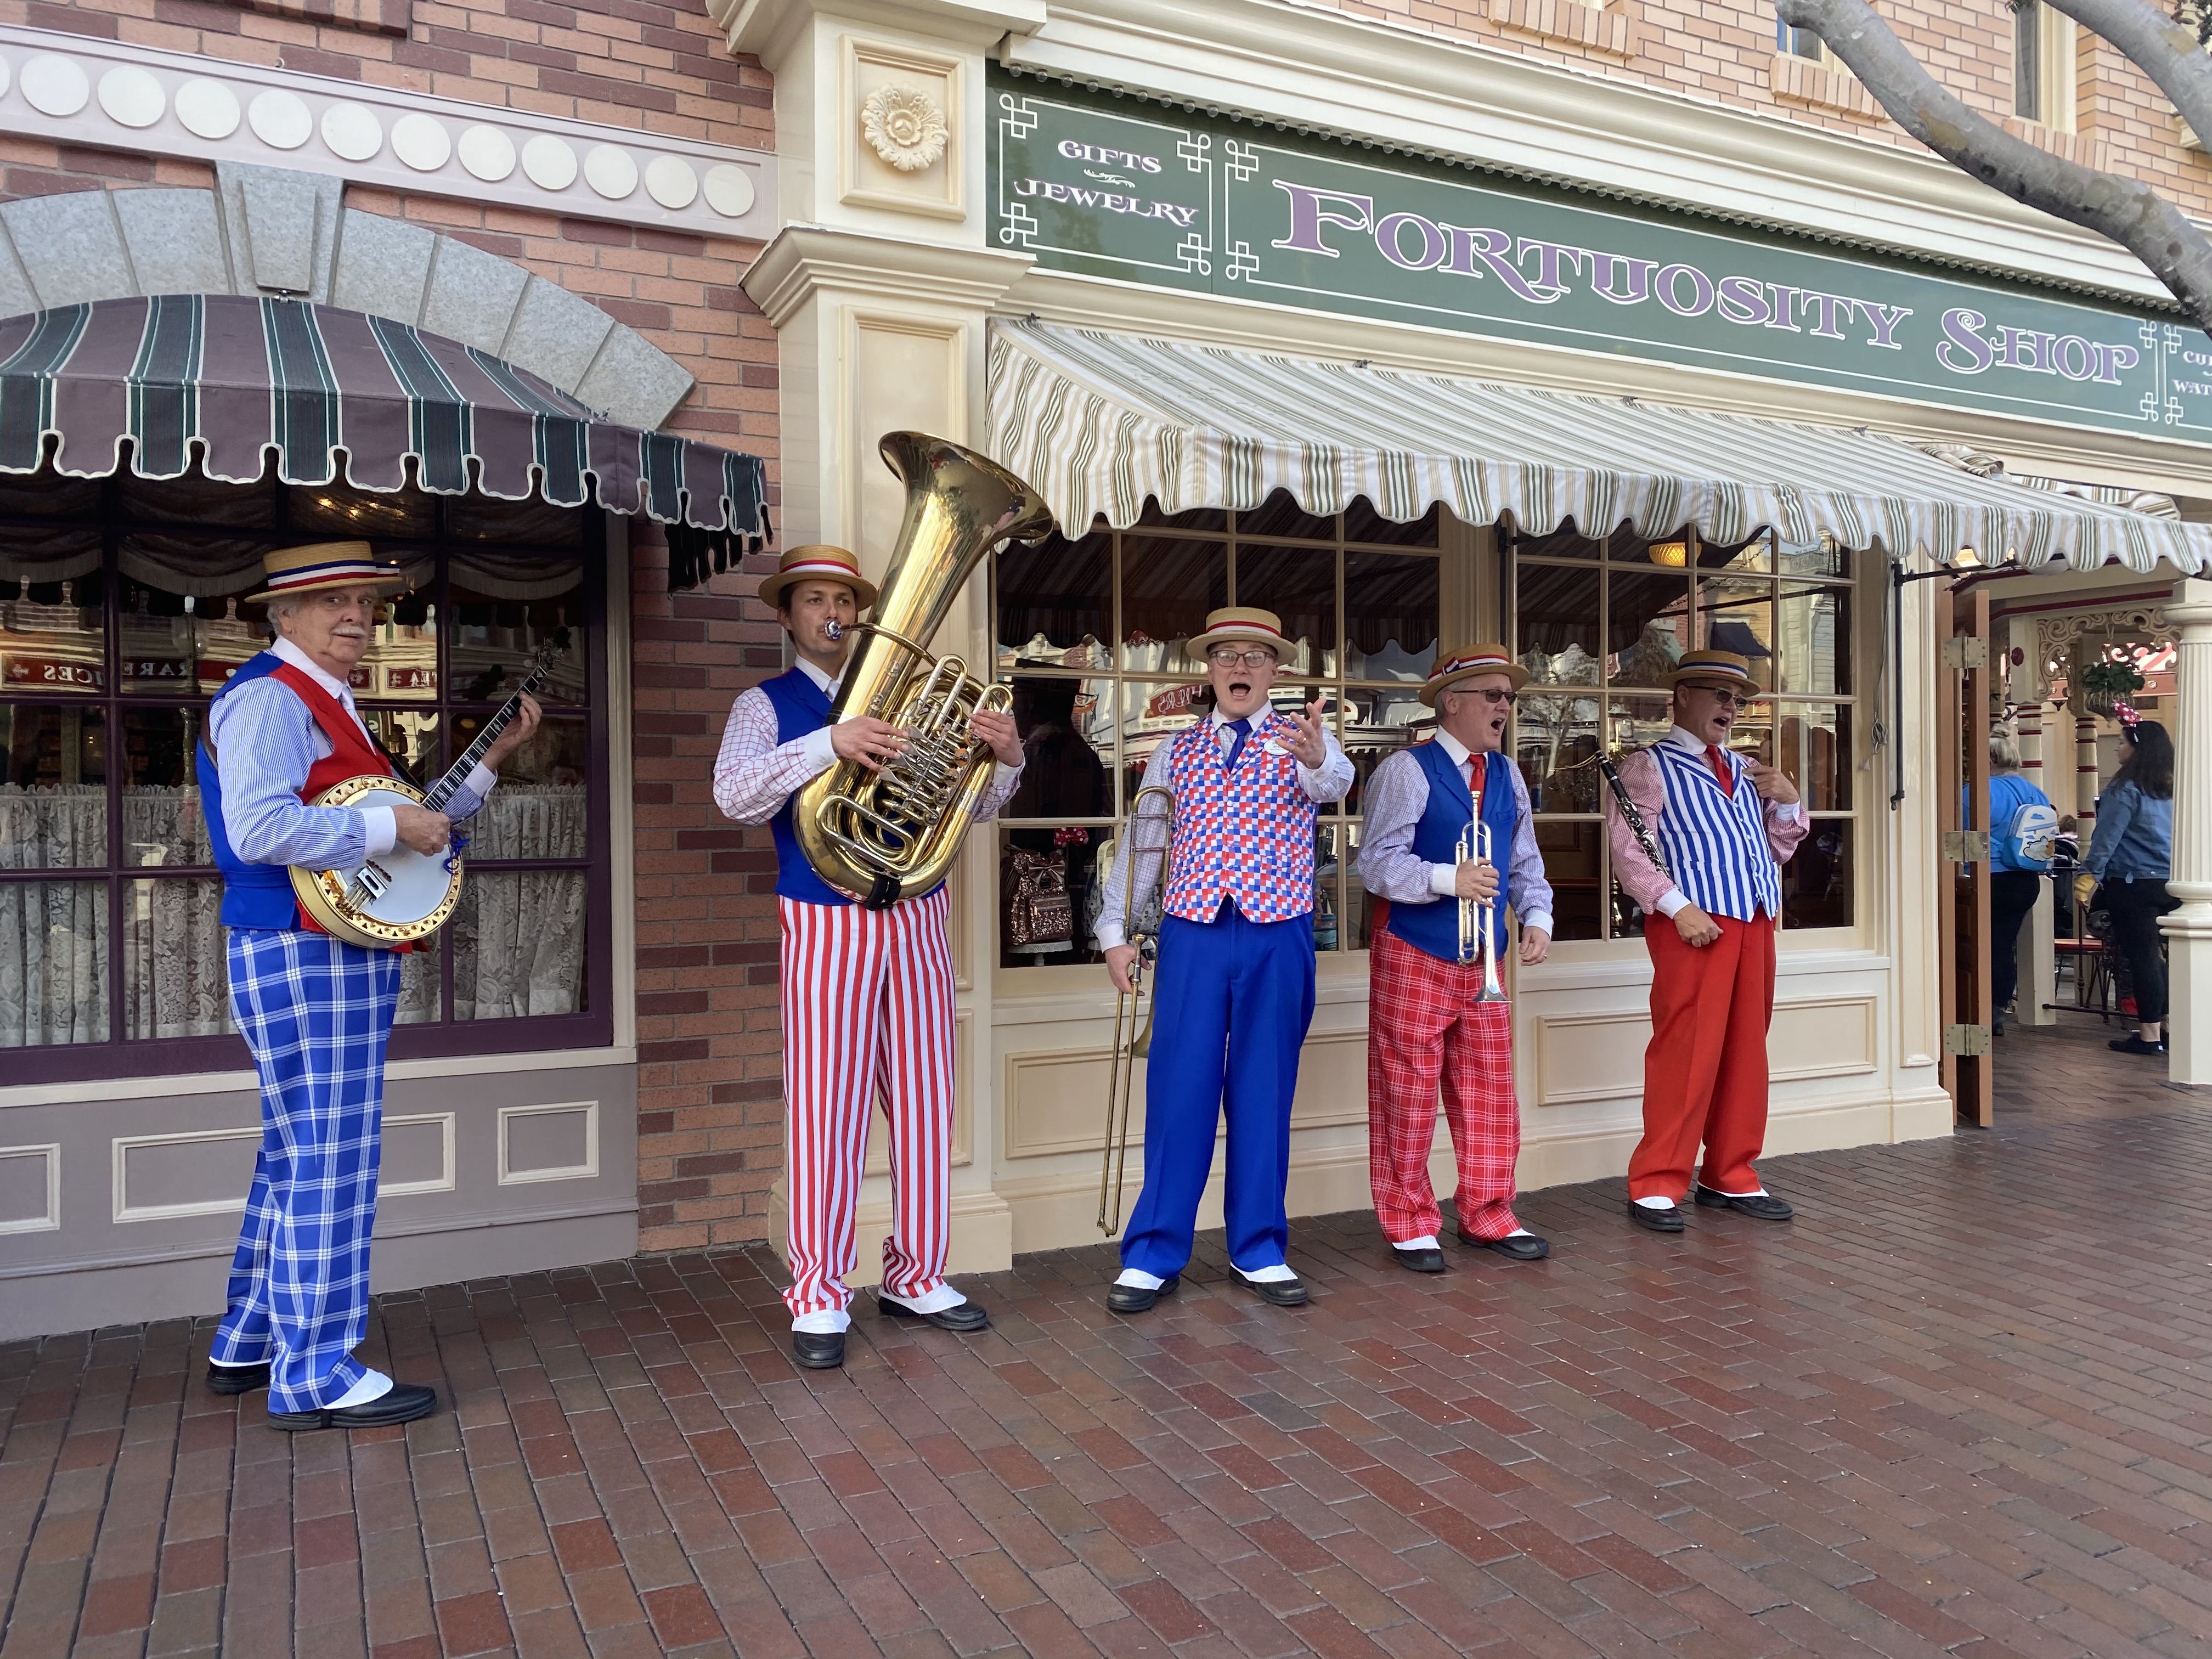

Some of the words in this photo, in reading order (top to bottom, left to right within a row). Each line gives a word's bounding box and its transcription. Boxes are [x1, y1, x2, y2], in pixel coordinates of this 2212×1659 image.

[1057, 140, 1162, 173] GIFTS
[1013, 178, 1199, 227] JEWELRY
[1271, 178, 1914, 350] FORTUOSITY
[1936, 307, 2140, 386] SHOP
